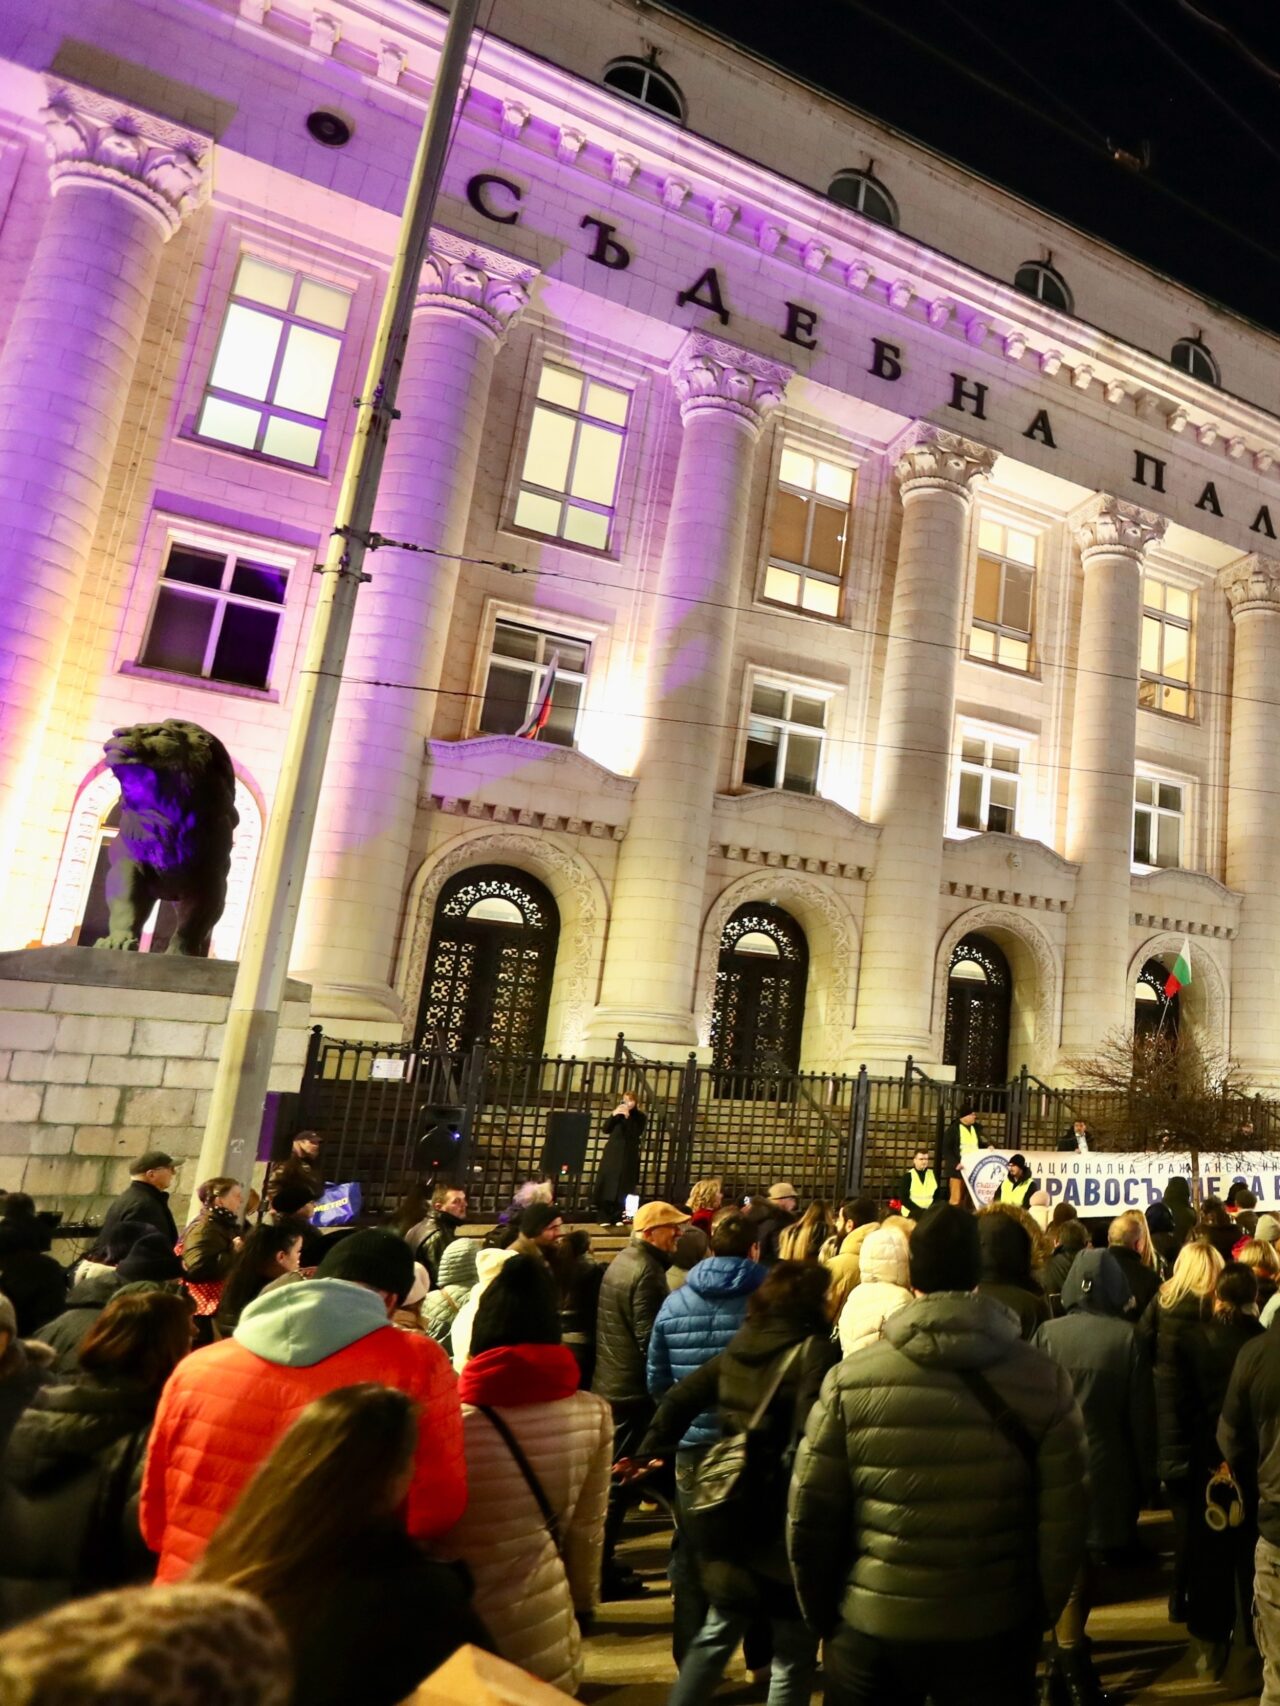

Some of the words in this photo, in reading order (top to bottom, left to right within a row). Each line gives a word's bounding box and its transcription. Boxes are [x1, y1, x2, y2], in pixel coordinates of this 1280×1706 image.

[466, 173, 1058, 449] СЪДЕБНА
[1147, 1162, 1254, 1175] ГРАЖАНСКА
[1031, 1176, 1221, 1207] РАВОСЪЕ
